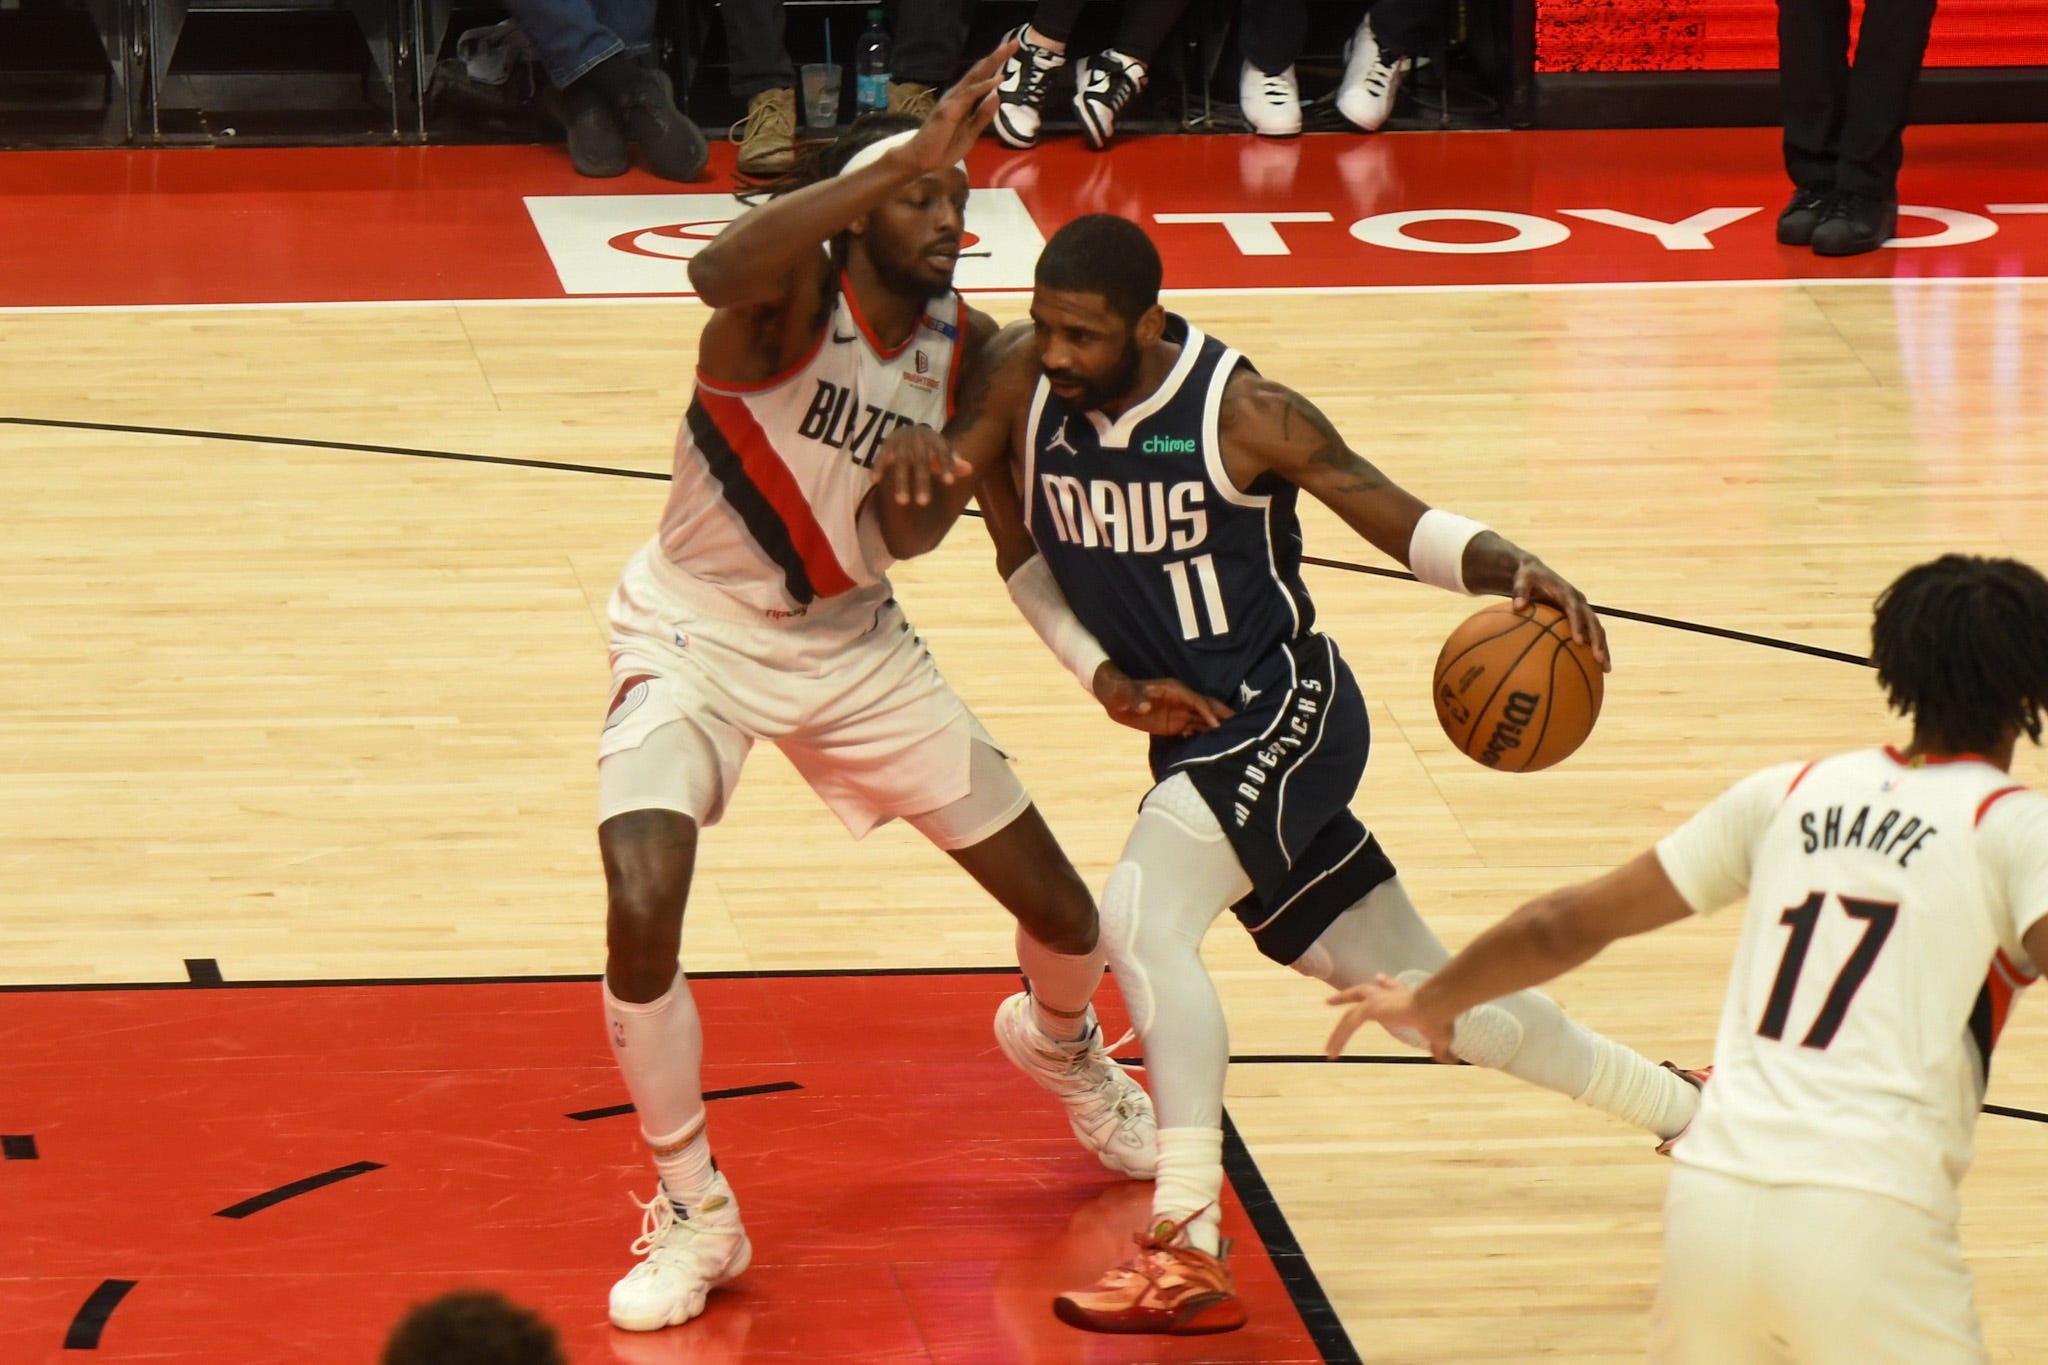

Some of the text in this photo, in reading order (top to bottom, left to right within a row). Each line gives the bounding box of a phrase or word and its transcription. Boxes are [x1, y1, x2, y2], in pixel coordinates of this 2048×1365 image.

[798, 378, 932, 469] BLZE
[1142, 435, 1196, 454] chime
[1041, 473, 1208, 553] MAVS
[1163, 553, 1229, 640] 11
[1800, 805, 1937, 868] SHARPE
[1756, 891, 1900, 1050] 17
